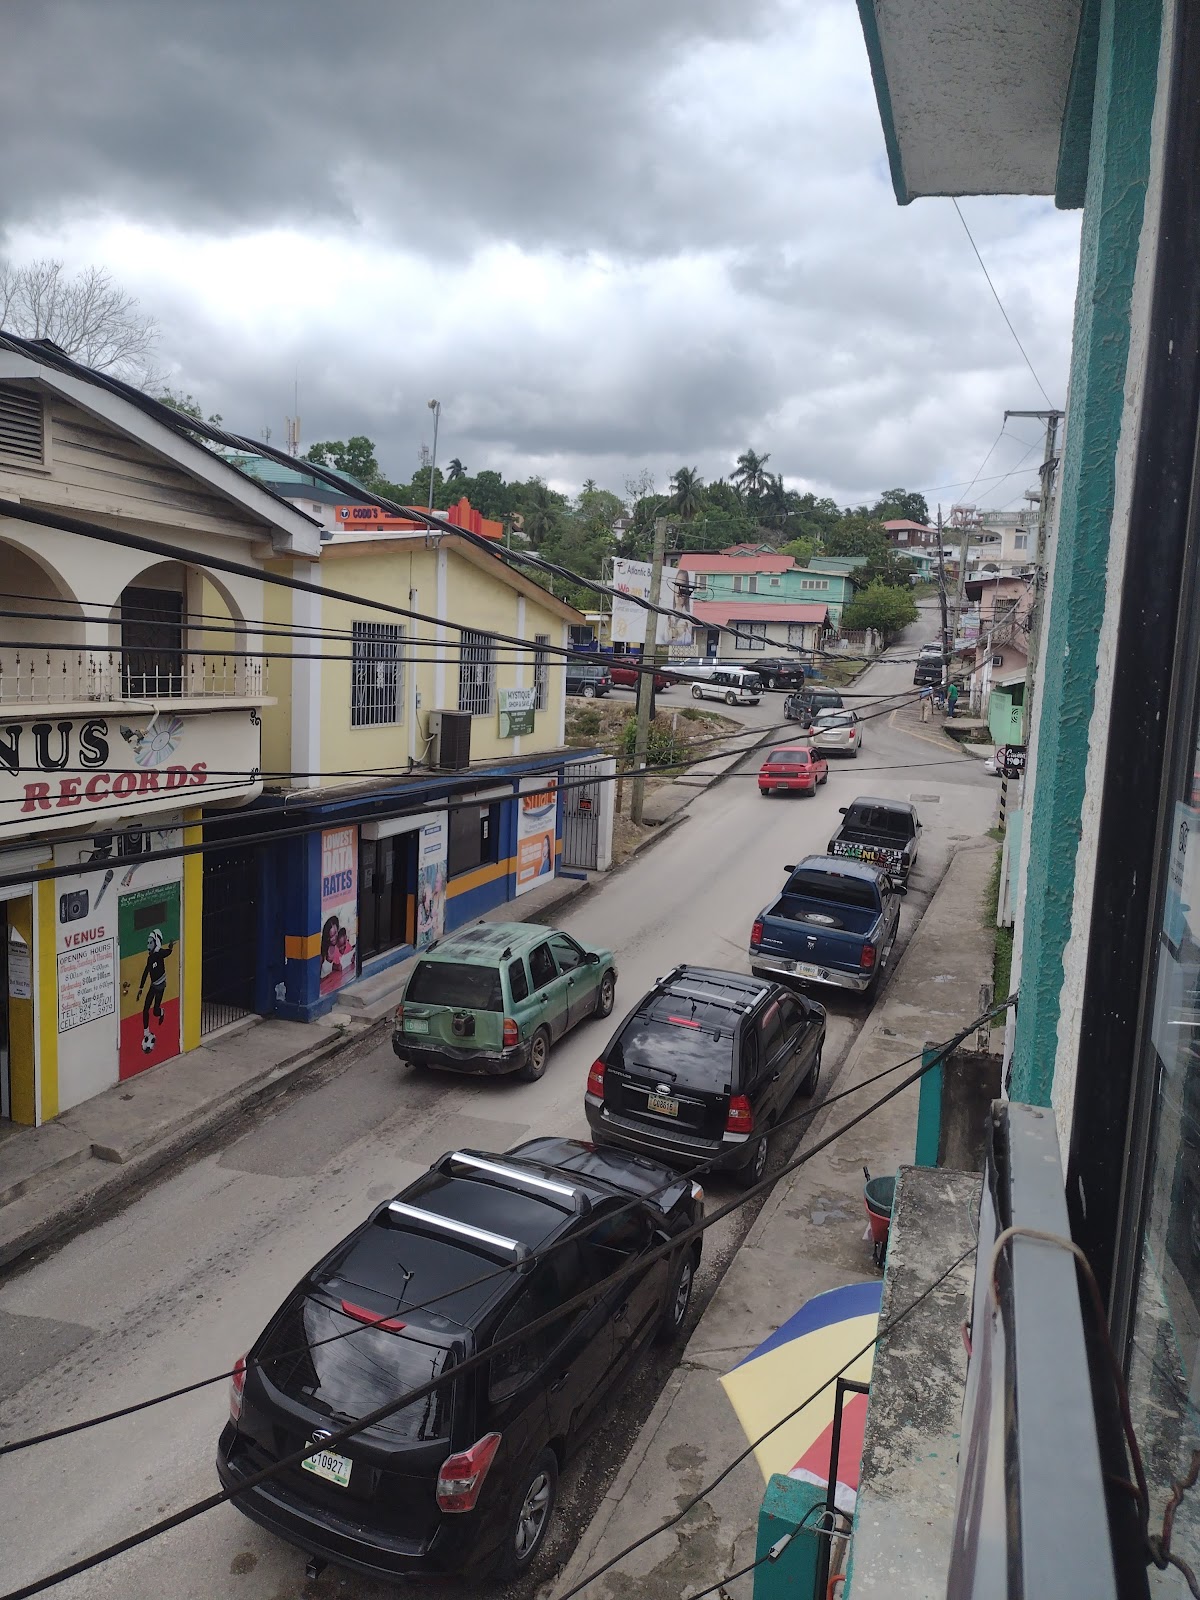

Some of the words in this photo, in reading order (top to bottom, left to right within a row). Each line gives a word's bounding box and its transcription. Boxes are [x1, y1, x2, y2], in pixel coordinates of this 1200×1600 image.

[627, 564, 646, 577] Atlantic
[20, 762, 208, 813] RECORDS
[323, 828, 354, 851] LOWEST
[323, 844, 353, 877] DATA
[847, 847, 888, 863] VENUS
[323, 869, 353, 897] RATES
[64, 926, 105, 949] VENUS
[60, 951, 88, 966] OPENING
[90, 944, 111, 956] HOURS
